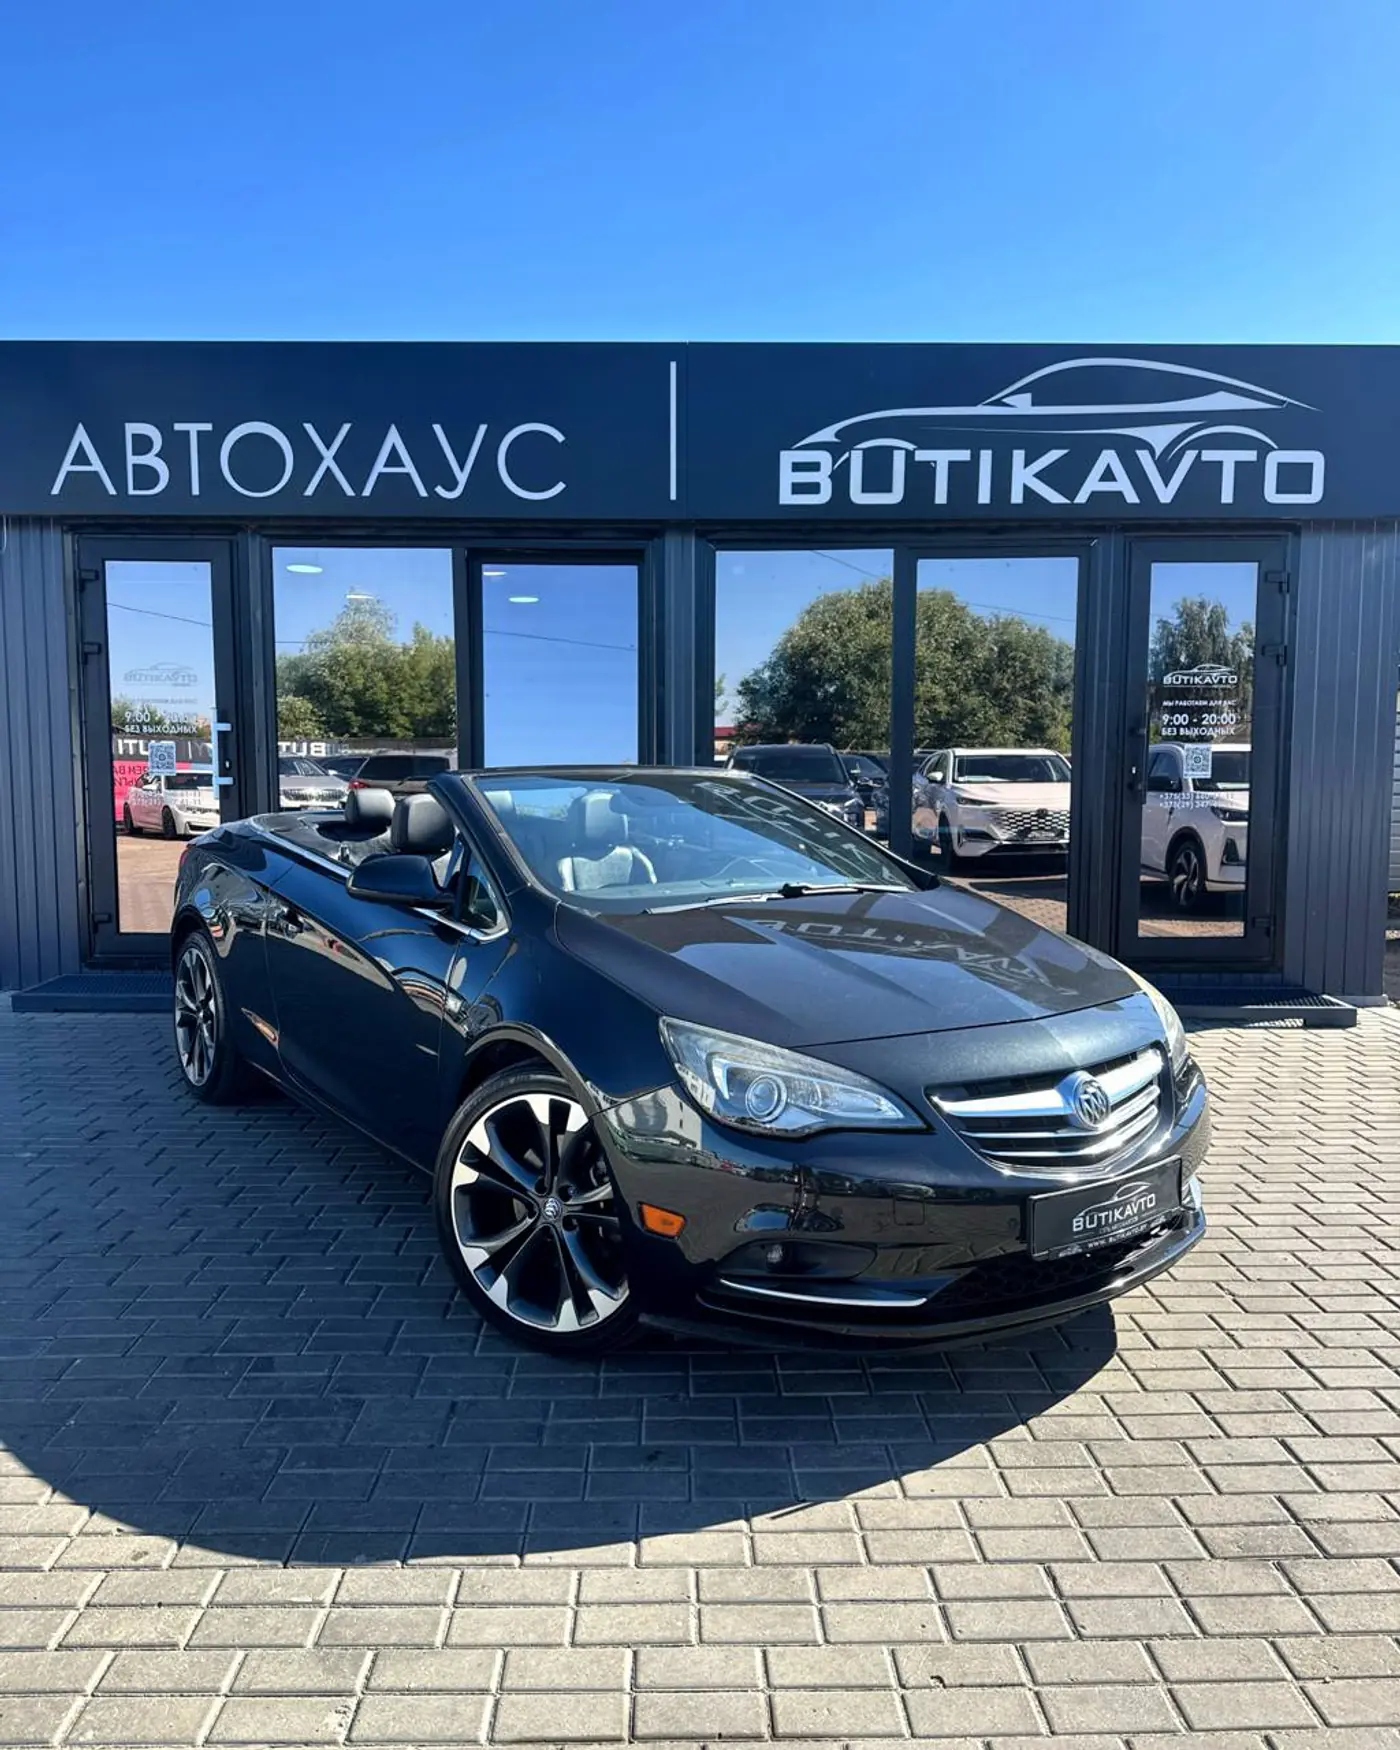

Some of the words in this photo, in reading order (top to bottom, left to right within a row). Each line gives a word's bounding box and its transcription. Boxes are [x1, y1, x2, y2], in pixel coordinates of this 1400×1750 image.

[50, 420, 567, 500] АВТОХАУС
[779, 449, 1325, 505] BUTIKAVTO
[1163, 675, 1238, 685] BUTIKAVTO
[1161, 727, 1177, 736] БЕЗ
[1179, 727, 1236, 736] ВЫХОДНЫХ
[1162, 713, 1190, 726] 9:00
[1201, 713, 1236, 725] 20:00
[1072, 1193, 1157, 1232] BUTIKAVTO
